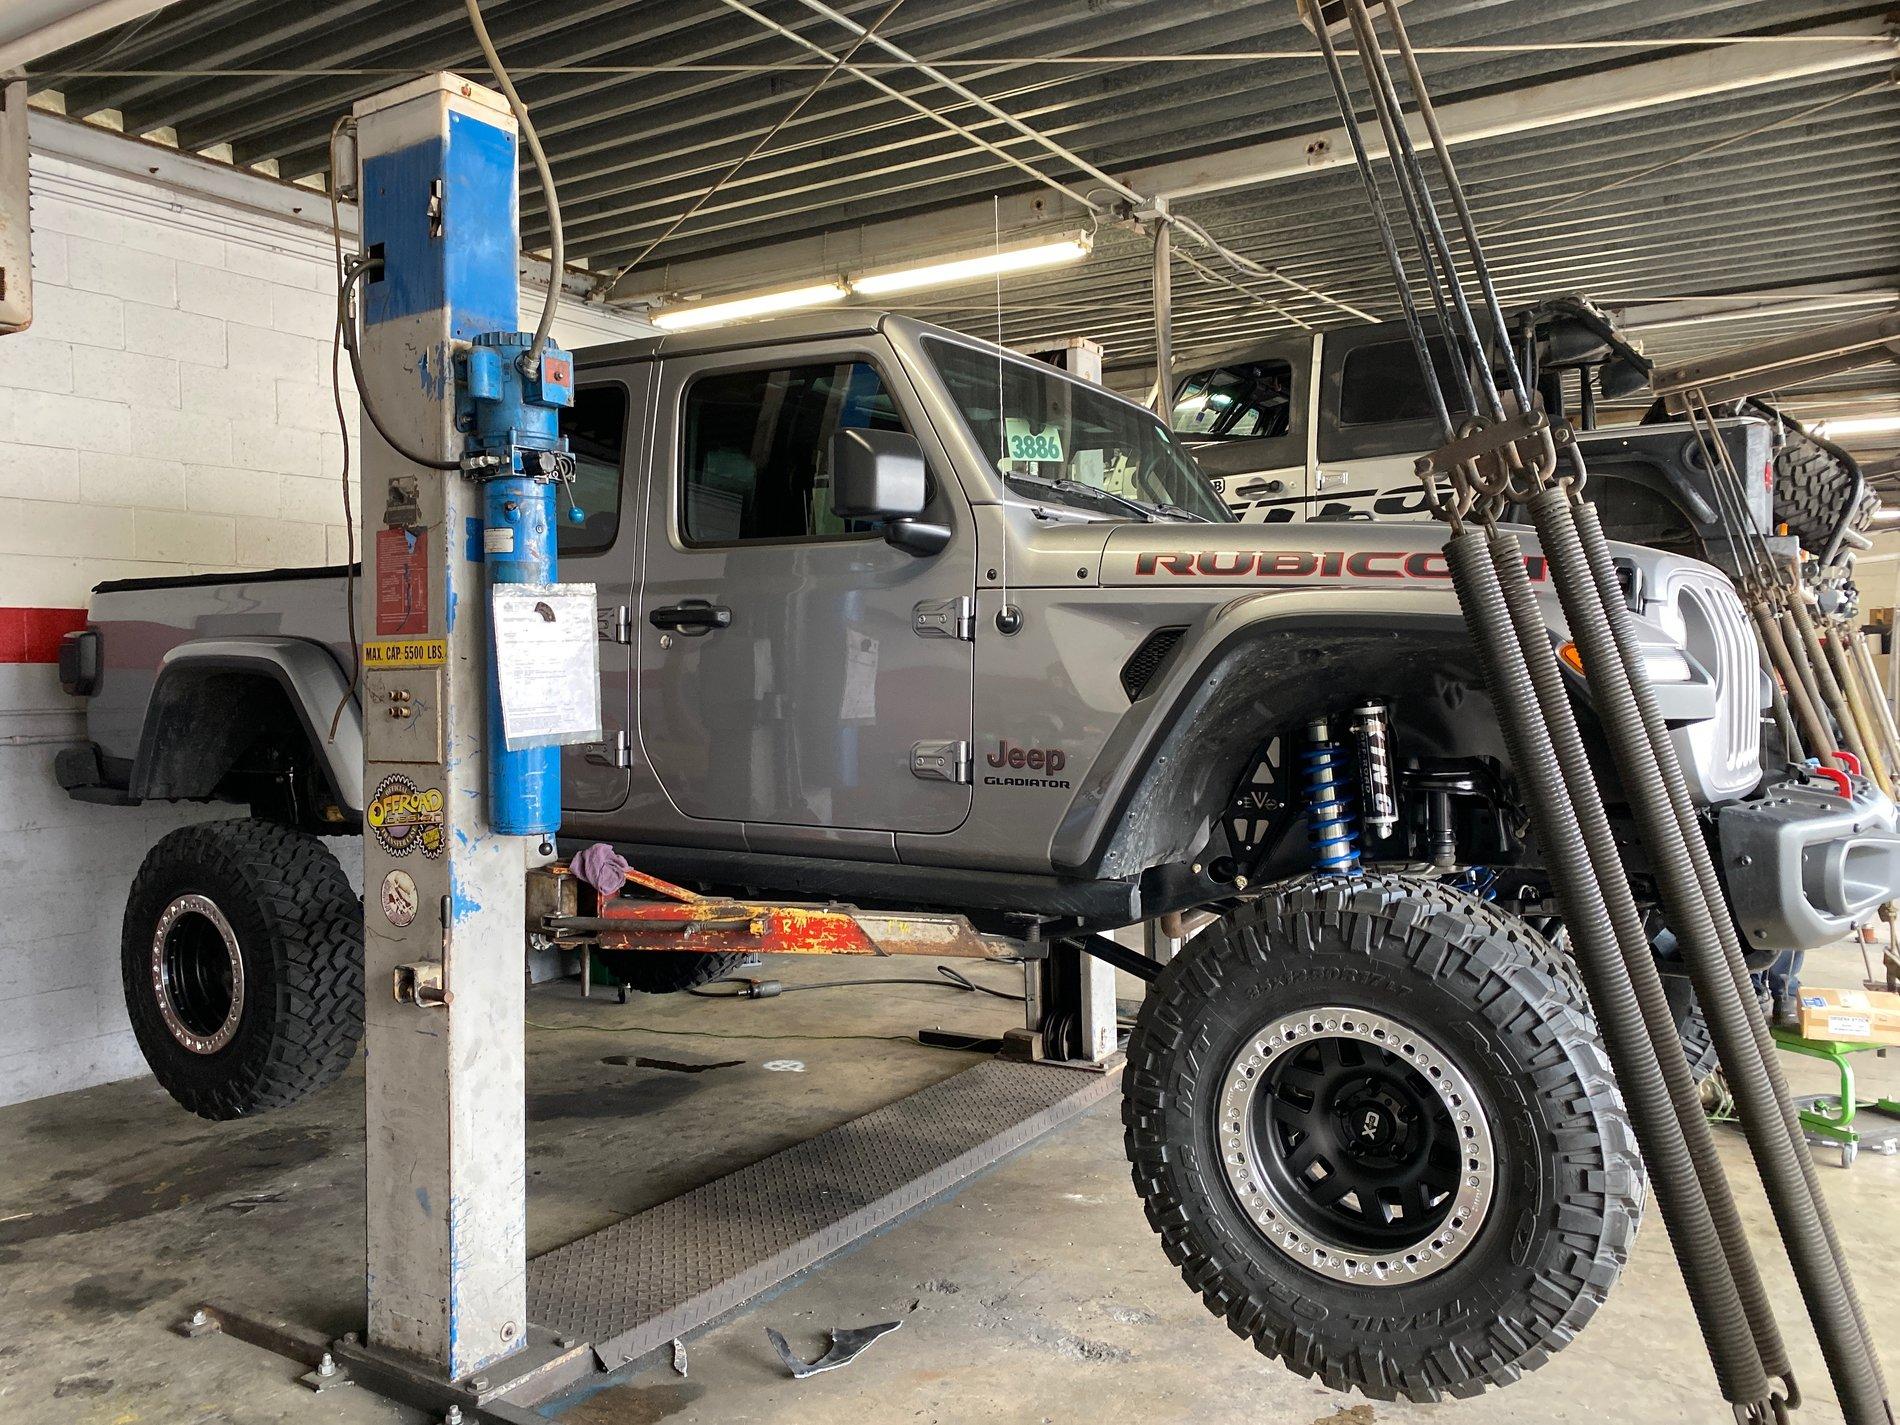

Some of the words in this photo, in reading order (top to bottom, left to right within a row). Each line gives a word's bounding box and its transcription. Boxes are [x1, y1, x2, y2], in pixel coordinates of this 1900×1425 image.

[1011, 435, 1060, 459] 3886
[366, 647, 383, 660] MAX.
[404, 646, 424, 659] 5500
[427, 645, 444, 659] LBS.
[986, 740, 1066, 776] Jeep
[984, 776, 1070, 789] GLADIATOR
[368, 788, 443, 827] OFFROAD
